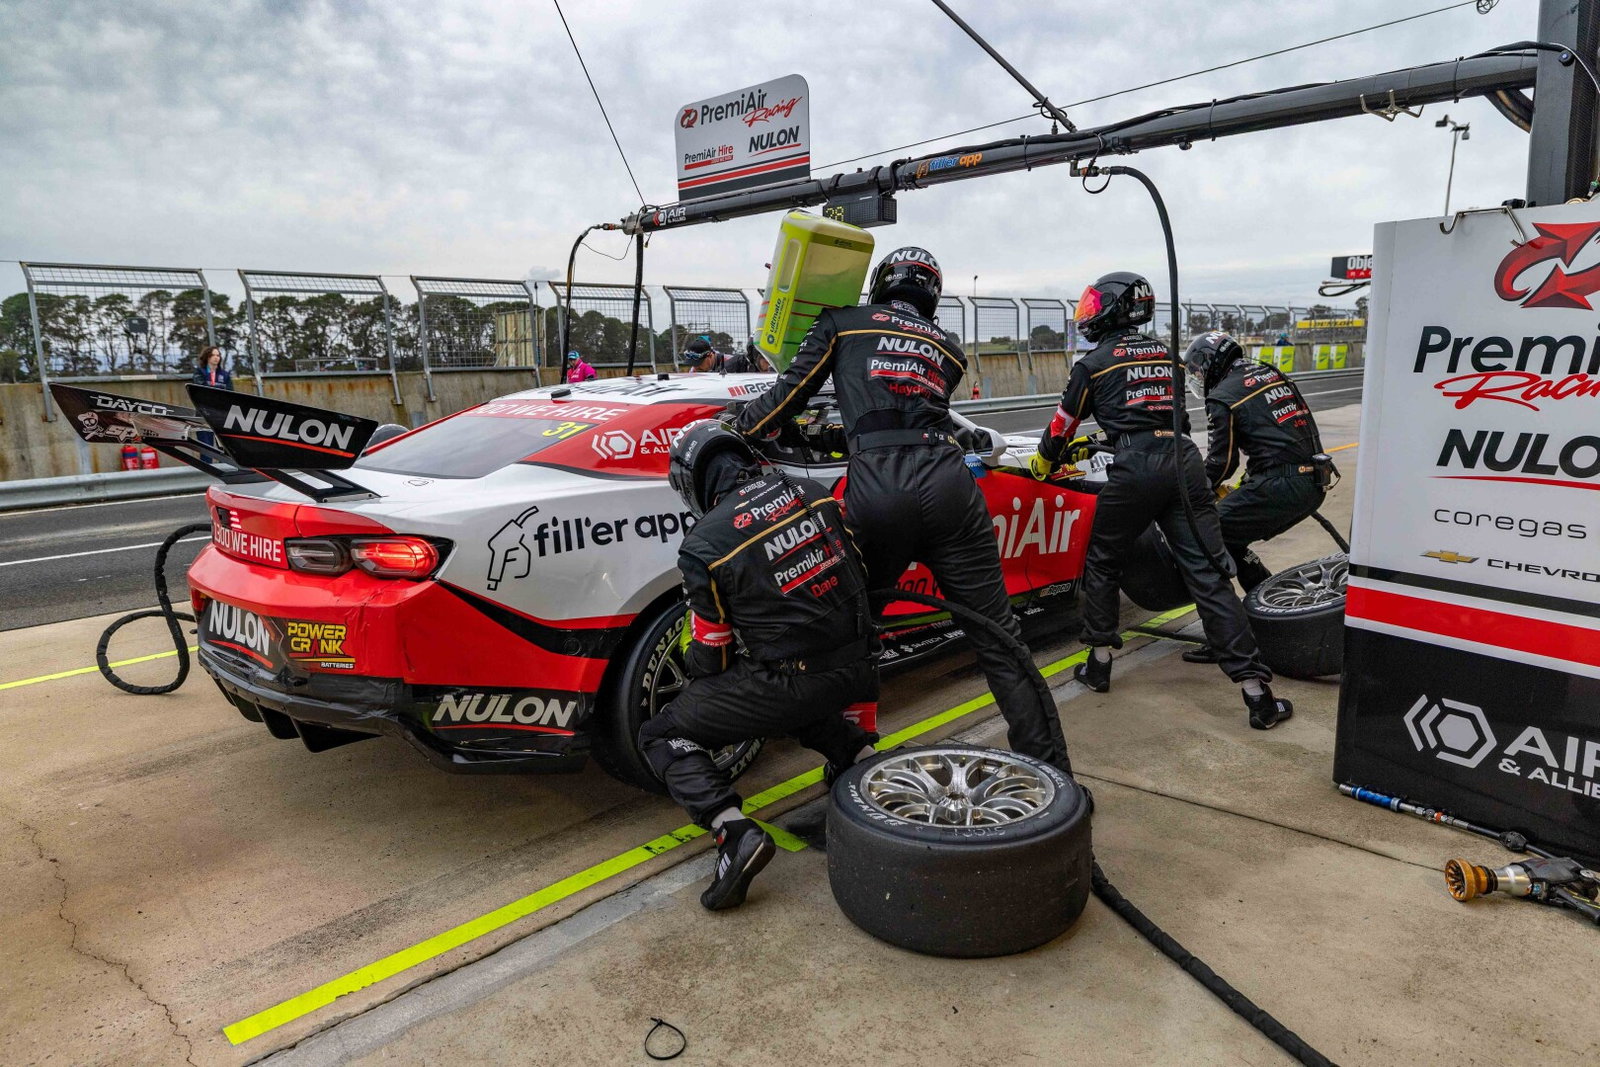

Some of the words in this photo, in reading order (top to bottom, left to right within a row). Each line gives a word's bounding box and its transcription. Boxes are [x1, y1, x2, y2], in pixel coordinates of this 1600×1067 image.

[701, 90, 767, 125] PremiAir
[748, 126, 799, 153] NULON
[684, 147, 716, 163] PremiAir
[717, 144, 734, 157] Hire
[960, 152, 983, 167] app
[668, 207, 686, 218] AIR
[877, 336, 945, 366] NULON
[1126, 345, 1167, 356] PremiAir
[870, 359, 925, 375] PremiAir
[1127, 366, 1173, 382] NULON
[1126, 386, 1165, 401] PremiAir
[96, 395, 168, 416] DAYCO
[543, 405, 628, 422] HIRE
[224, 405, 354, 450] NULON
[542, 421, 588, 440] 31
[1436, 429, 1600, 479] NULO
[751, 479, 785, 501] CHEVROLE
[1434, 508, 1588, 539] coregas
[231, 530, 248, 555] WE
[250, 535, 282, 562] HIRE
[774, 548, 824, 587] PremiAir
[209, 599, 270, 657] NULON
[288, 622, 347, 641] POWER
[321, 661, 355, 670] BATTERIES
[432, 694, 577, 728] NULON
[1498, 758, 1521, 777] &
